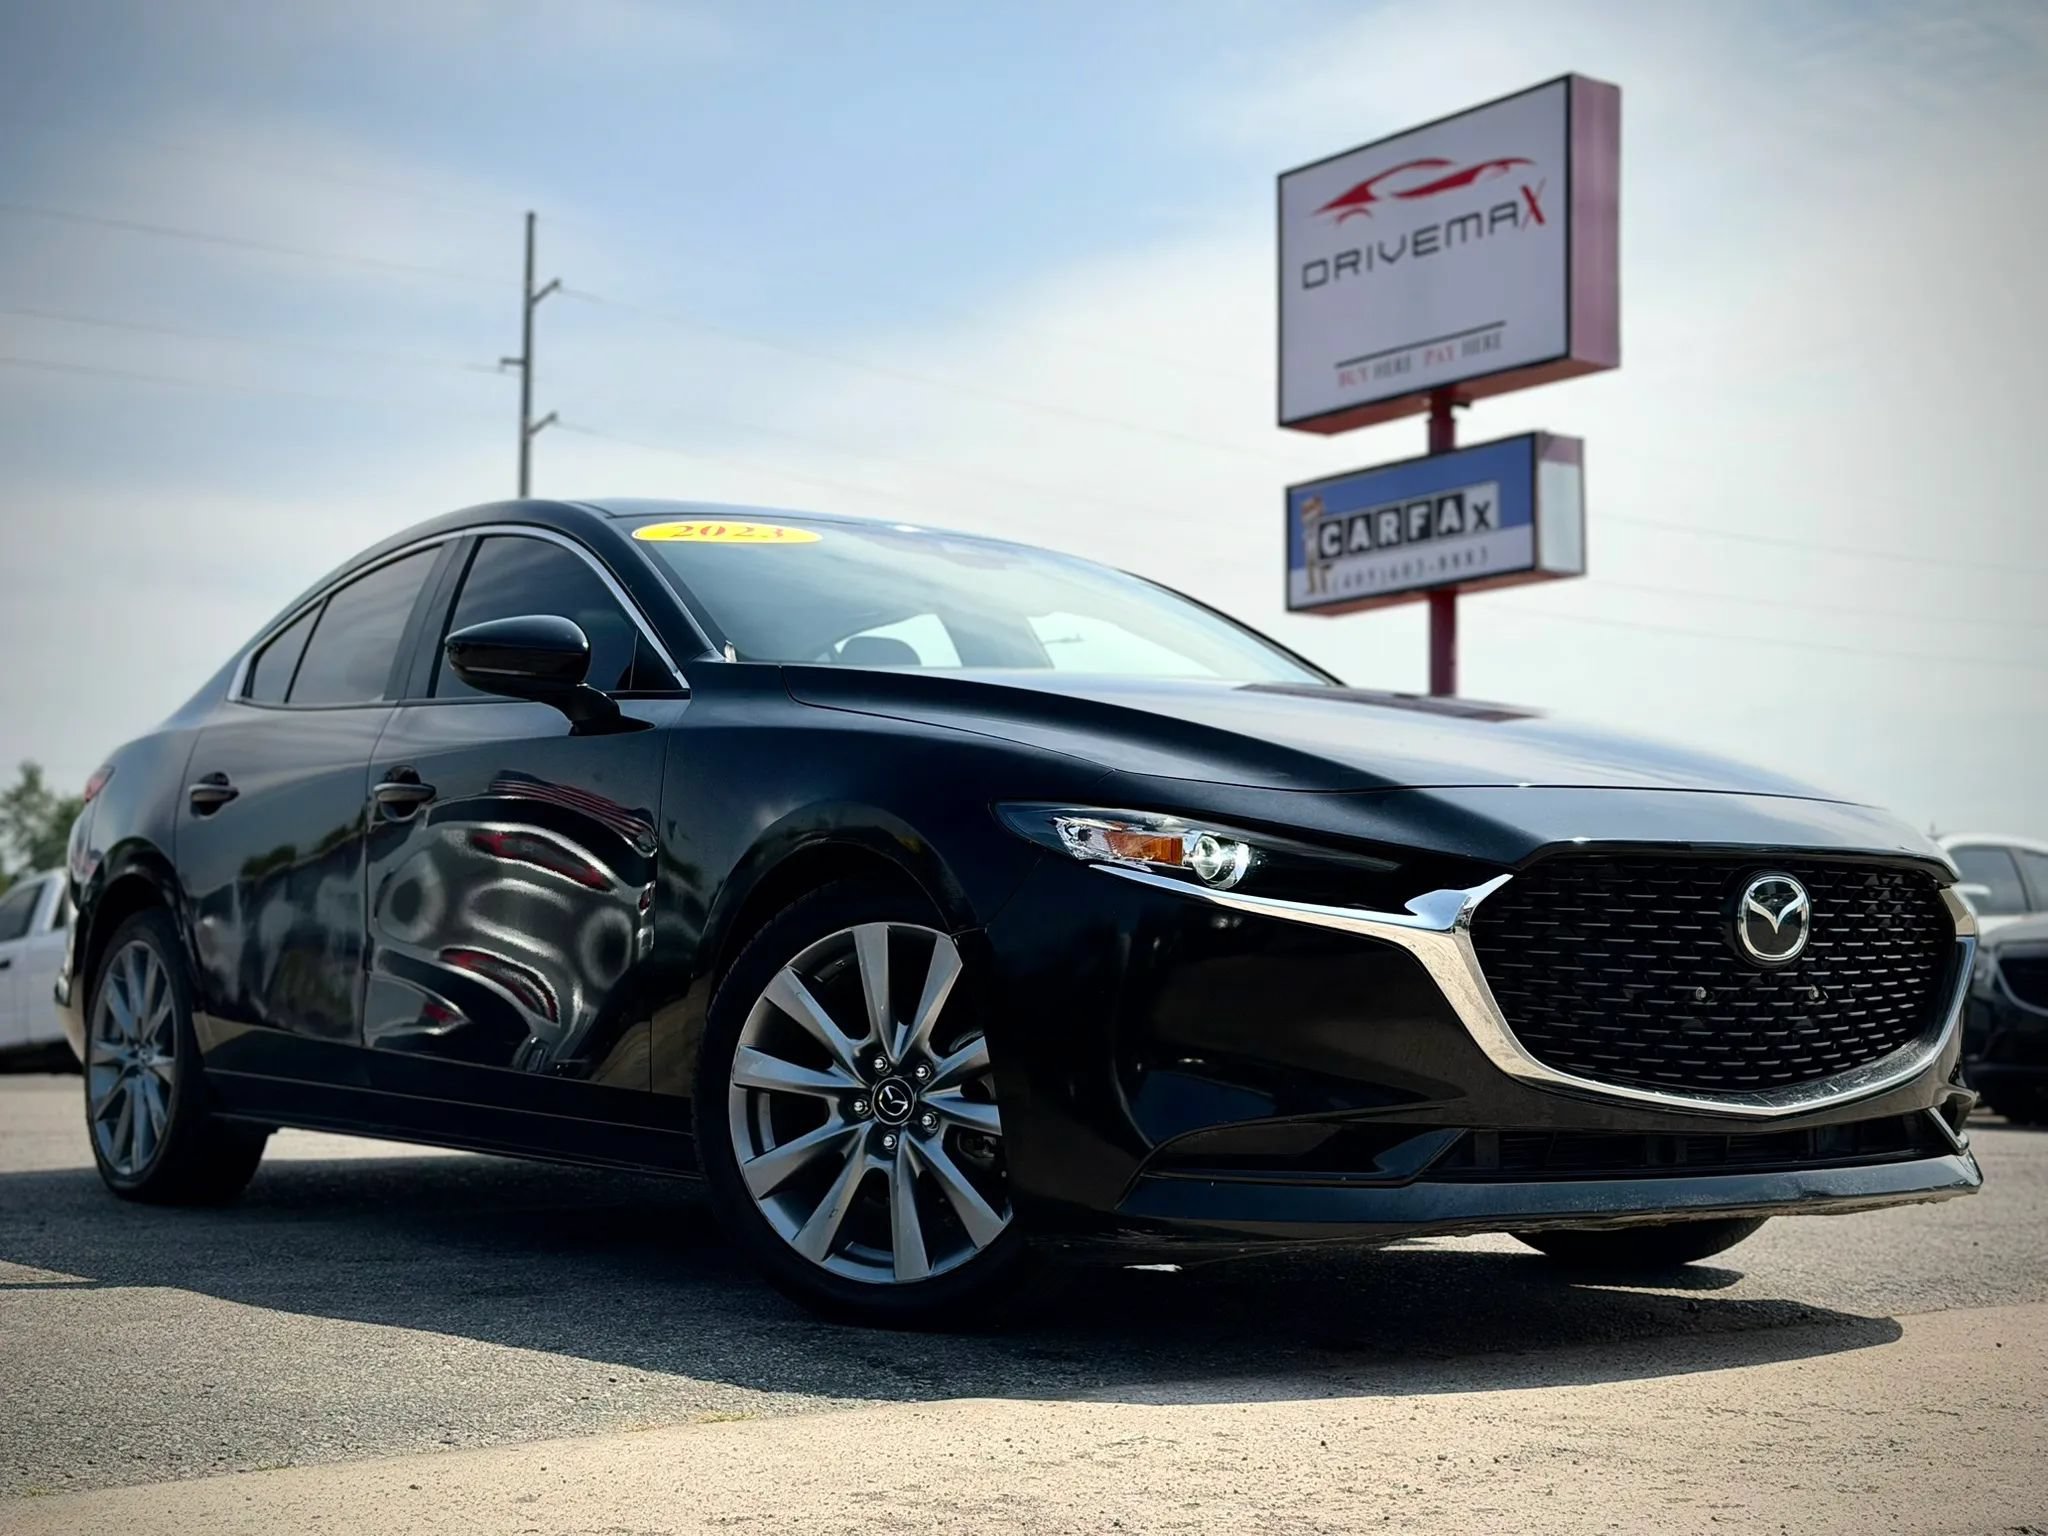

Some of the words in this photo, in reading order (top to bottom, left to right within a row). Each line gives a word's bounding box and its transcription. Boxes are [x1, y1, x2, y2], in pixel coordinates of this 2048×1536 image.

[1301, 178, 1546, 290] DRIVEMAX
[671, 525, 784, 538] 2023
[1319, 499, 1492, 558] CARFAX
